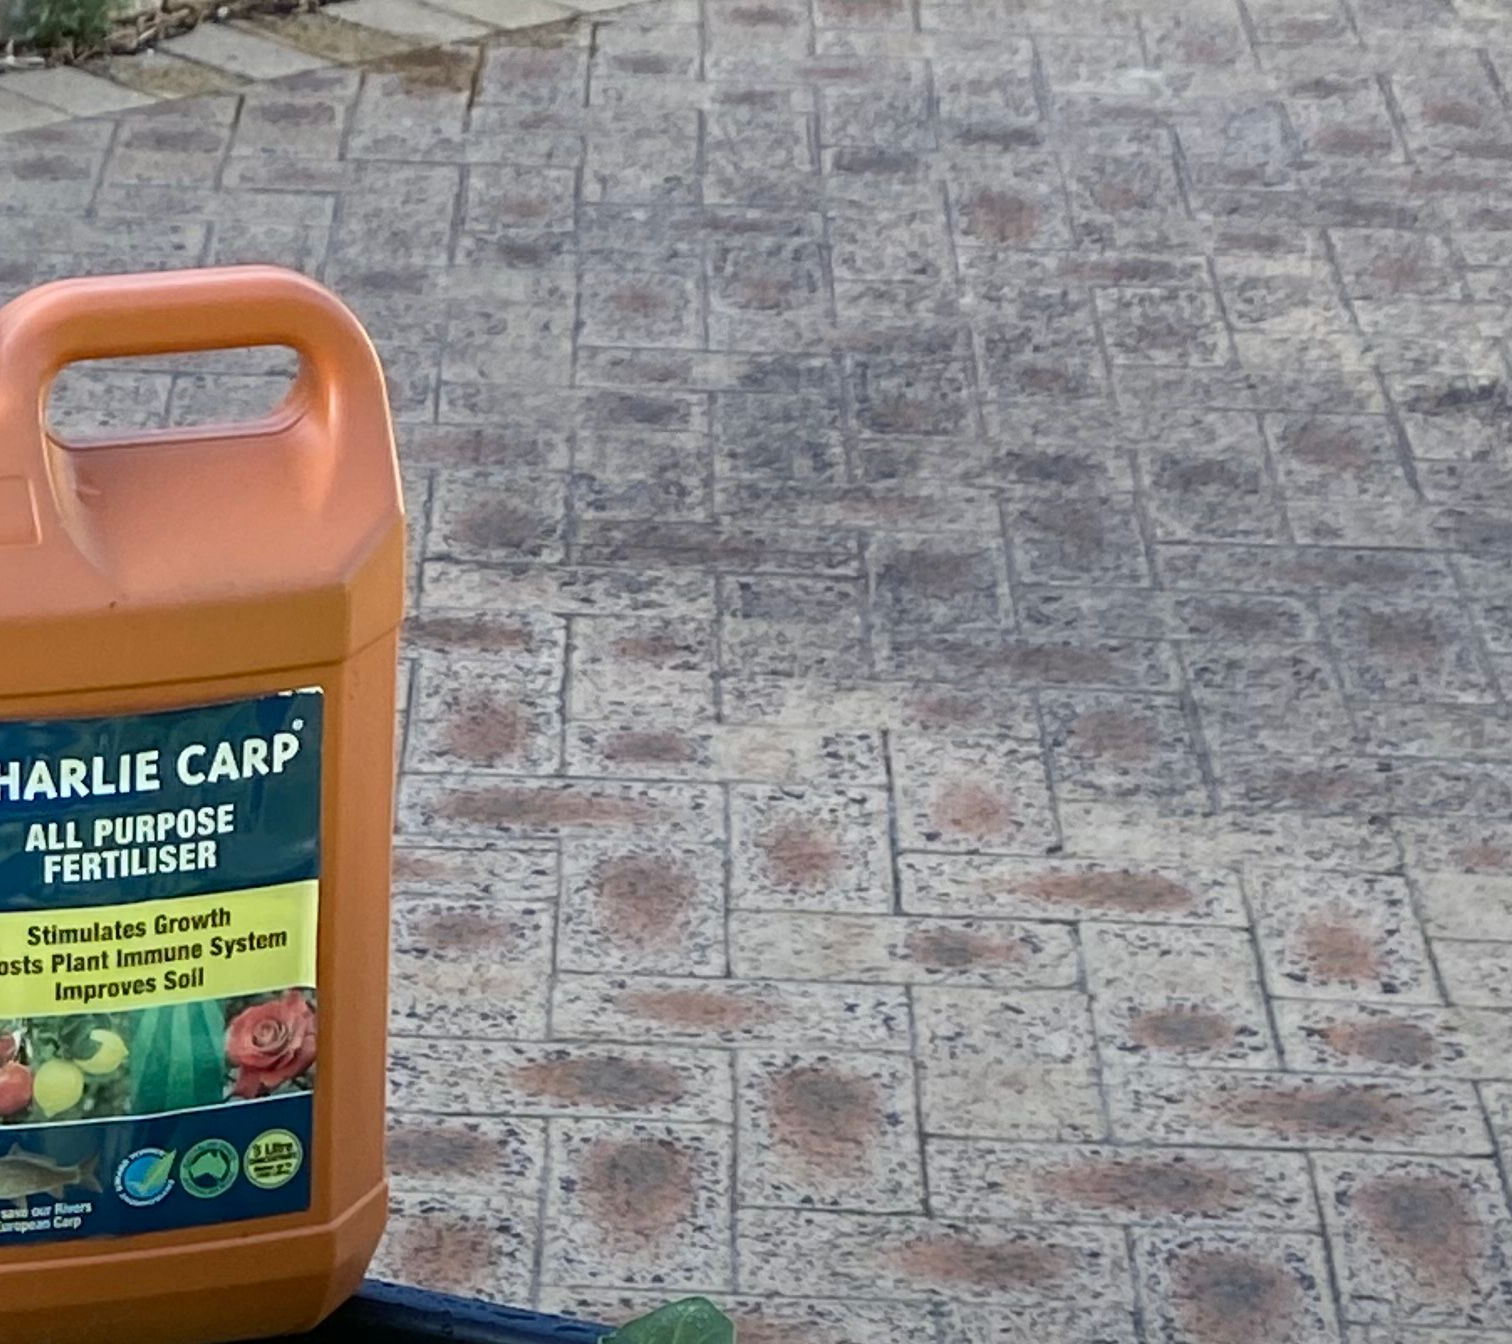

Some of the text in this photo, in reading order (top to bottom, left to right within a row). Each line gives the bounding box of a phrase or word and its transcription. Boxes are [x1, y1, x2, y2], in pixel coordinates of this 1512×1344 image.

[25, 804, 234, 851] ALL PURPOSE
[44, 841, 217, 883] FERTILISER
[27, 907, 231, 946] Stimulates Growth
[51, 949, 109, 974] Plant
[117, 942, 203, 967] Immune
[210, 930, 287, 959] System
[55, 967, 204, 1003] Improves Soil
[0, 1208, 29, 1219] save
[31, 1206, 52, 1217] our
[55, 1202, 92, 1215] Rivers
[53, 1216, 82, 1229] Carp
